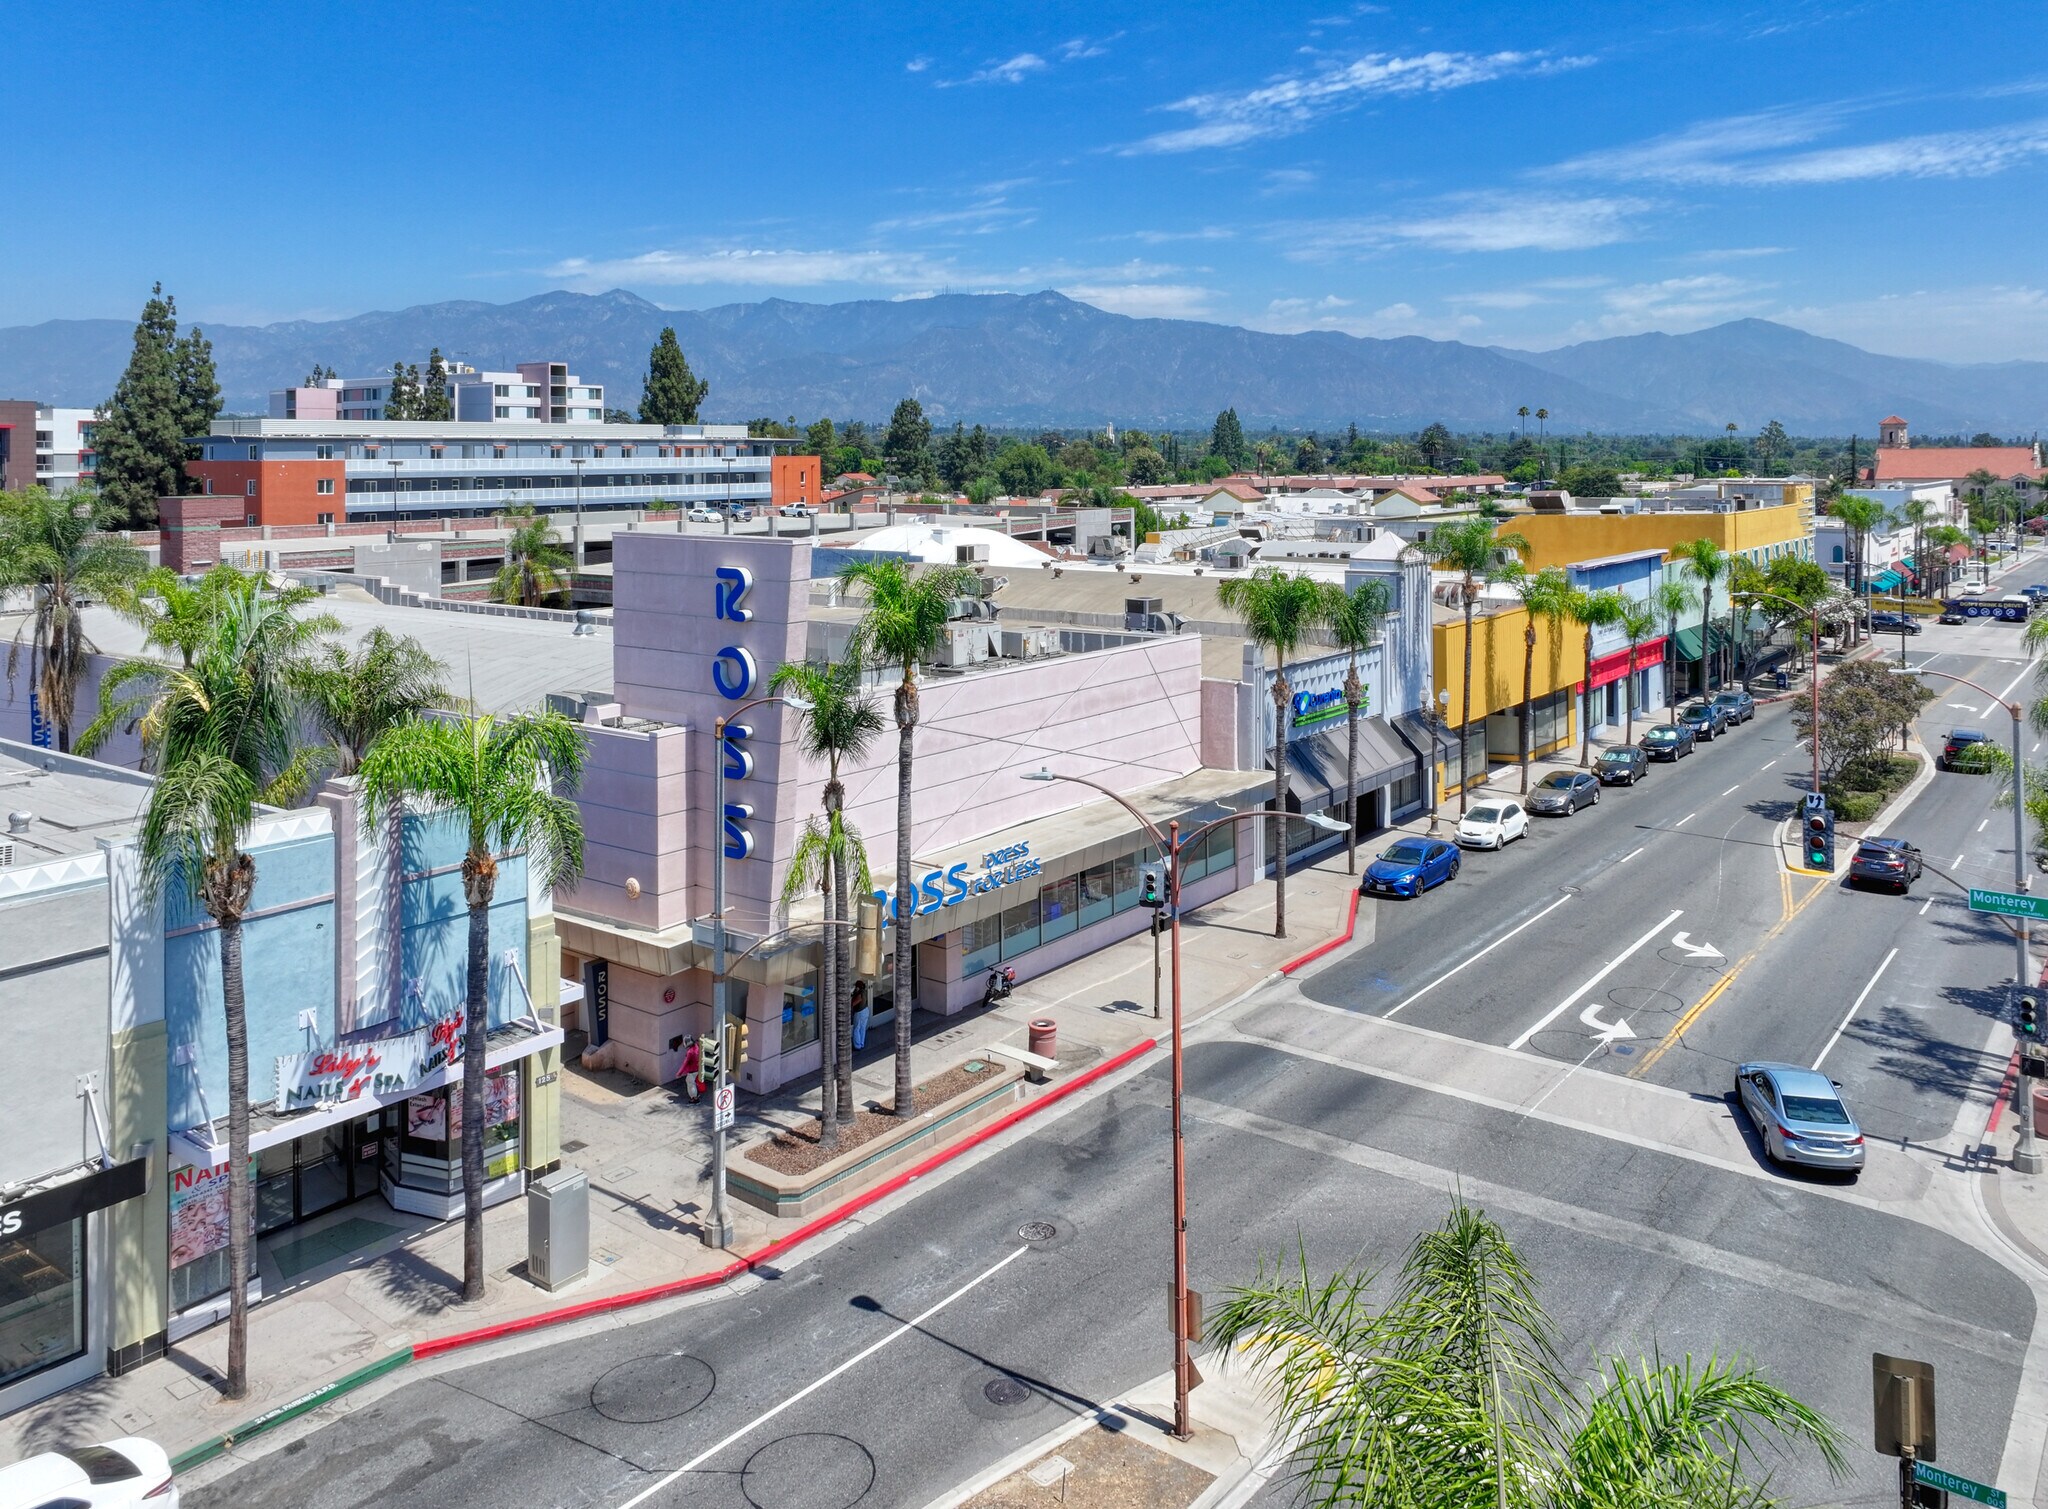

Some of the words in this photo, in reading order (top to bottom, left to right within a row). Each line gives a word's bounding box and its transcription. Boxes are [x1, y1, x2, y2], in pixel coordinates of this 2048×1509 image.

[713, 567, 755, 860] ROSS
[983, 840, 1030, 869] DRESS
[974, 870, 1004, 894] FOR
[1006, 857, 1041, 884] LESS
[1973, 890, 2036, 912] Monterey
[598, 971, 607, 1021] ROSS
[309, 1047, 382, 1080] Lily's
[420, 1047, 448, 1077] NAILS
[287, 1080, 344, 1104] NAILS
[348, 1075, 372, 1100] &
[208, 1174, 228, 1188] SP
[0, 1210, 22, 1237] S
[282, 1393, 316, 1412] PARKING
[1916, 1463, 1977, 1498] Monterey
[1990, 1489, 2000, 1498] ST
